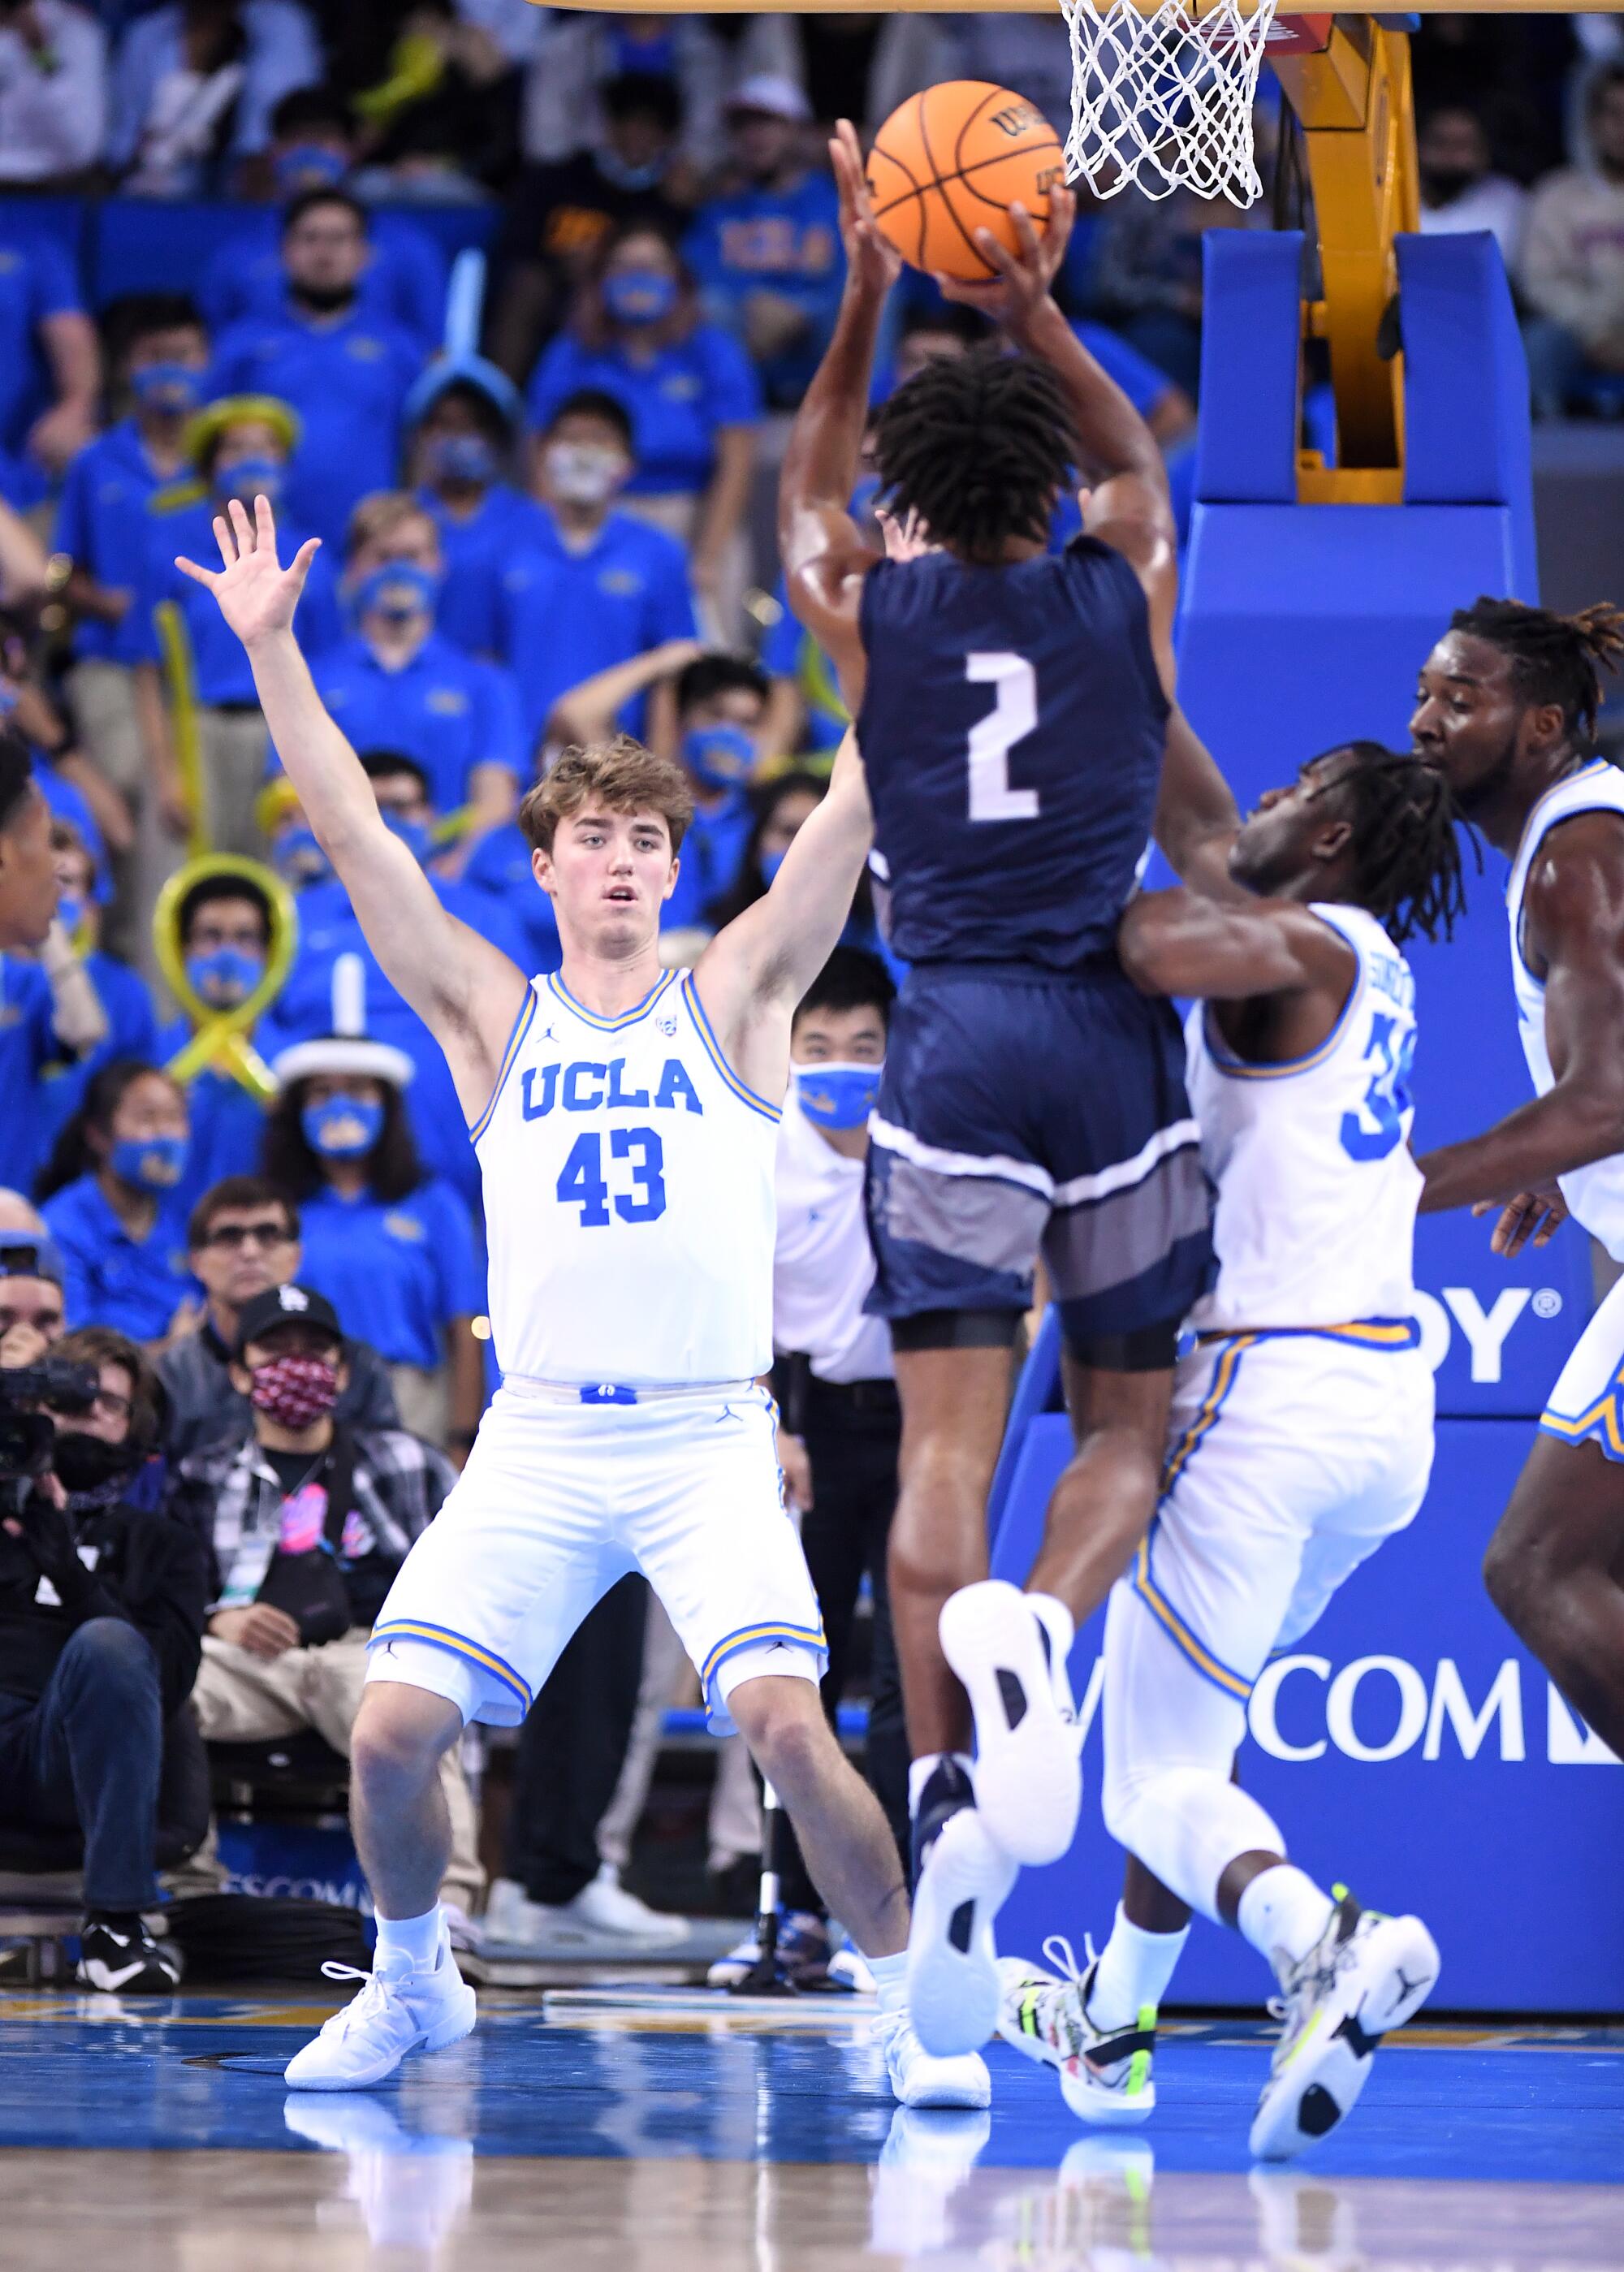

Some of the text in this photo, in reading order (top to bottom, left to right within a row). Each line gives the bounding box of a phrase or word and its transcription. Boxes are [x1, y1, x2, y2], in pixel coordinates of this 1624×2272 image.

[966, 652, 1039, 821] 2
[520, 1057, 704, 1122] UCLA
[556, 1126, 667, 1228] 43
